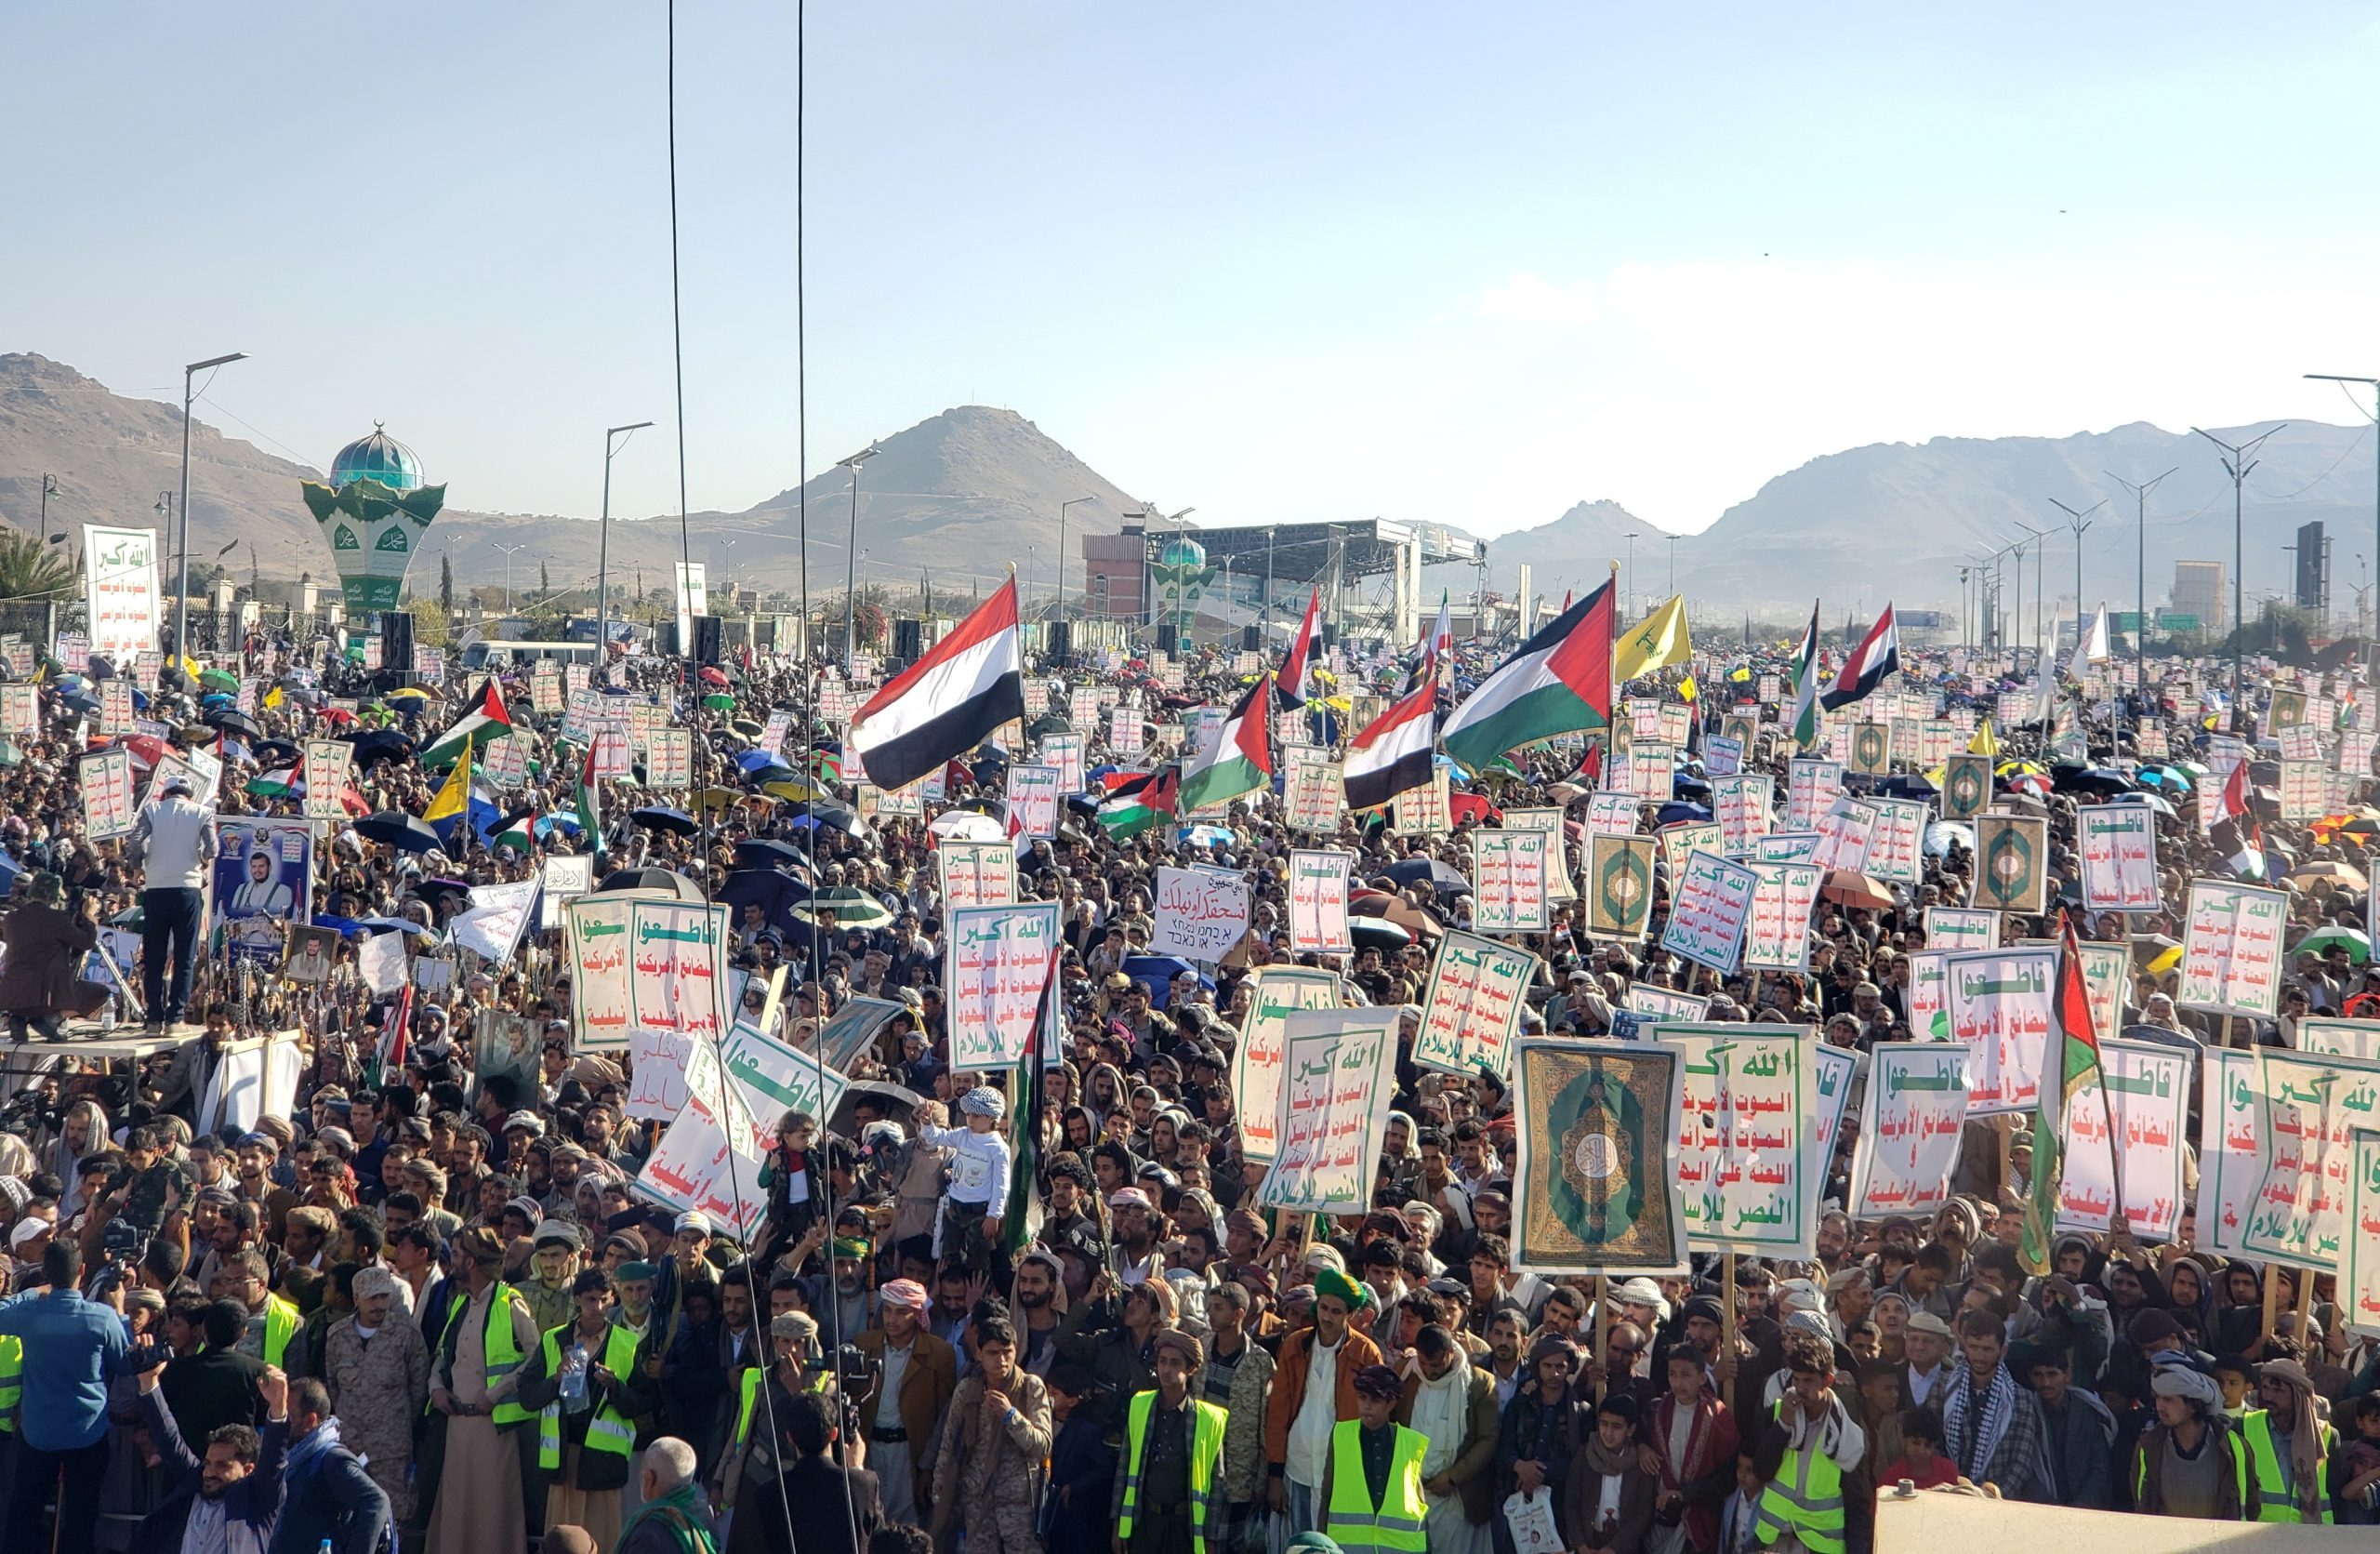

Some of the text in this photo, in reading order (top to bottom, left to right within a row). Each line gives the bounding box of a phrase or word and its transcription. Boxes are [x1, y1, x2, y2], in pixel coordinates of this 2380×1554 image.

[986, 850, 1009, 865] الله
[1519, 836, 1541, 852] الله
[1726, 875, 1751, 892] الله
[2248, 897, 2280, 919] الله
[637, 914, 716, 945] قاطعوا
[959, 912, 1050, 950] الله أكبر
[1446, 946, 1524, 980] الله أكبر
[1959, 961, 2045, 1004] قاطعوا
[1294, 1040, 1376, 1086] الله أكبر
[1742, 1044, 1792, 1076] الله
[1886, 1057, 1963, 1100] قاطعوا
[2273, 1069, 2341, 1108] أكبر
[1735, 1092, 1792, 1115] الموت
[1736, 1128, 1792, 1152] الموت
[1732, 1192, 1791, 1231] النصر
